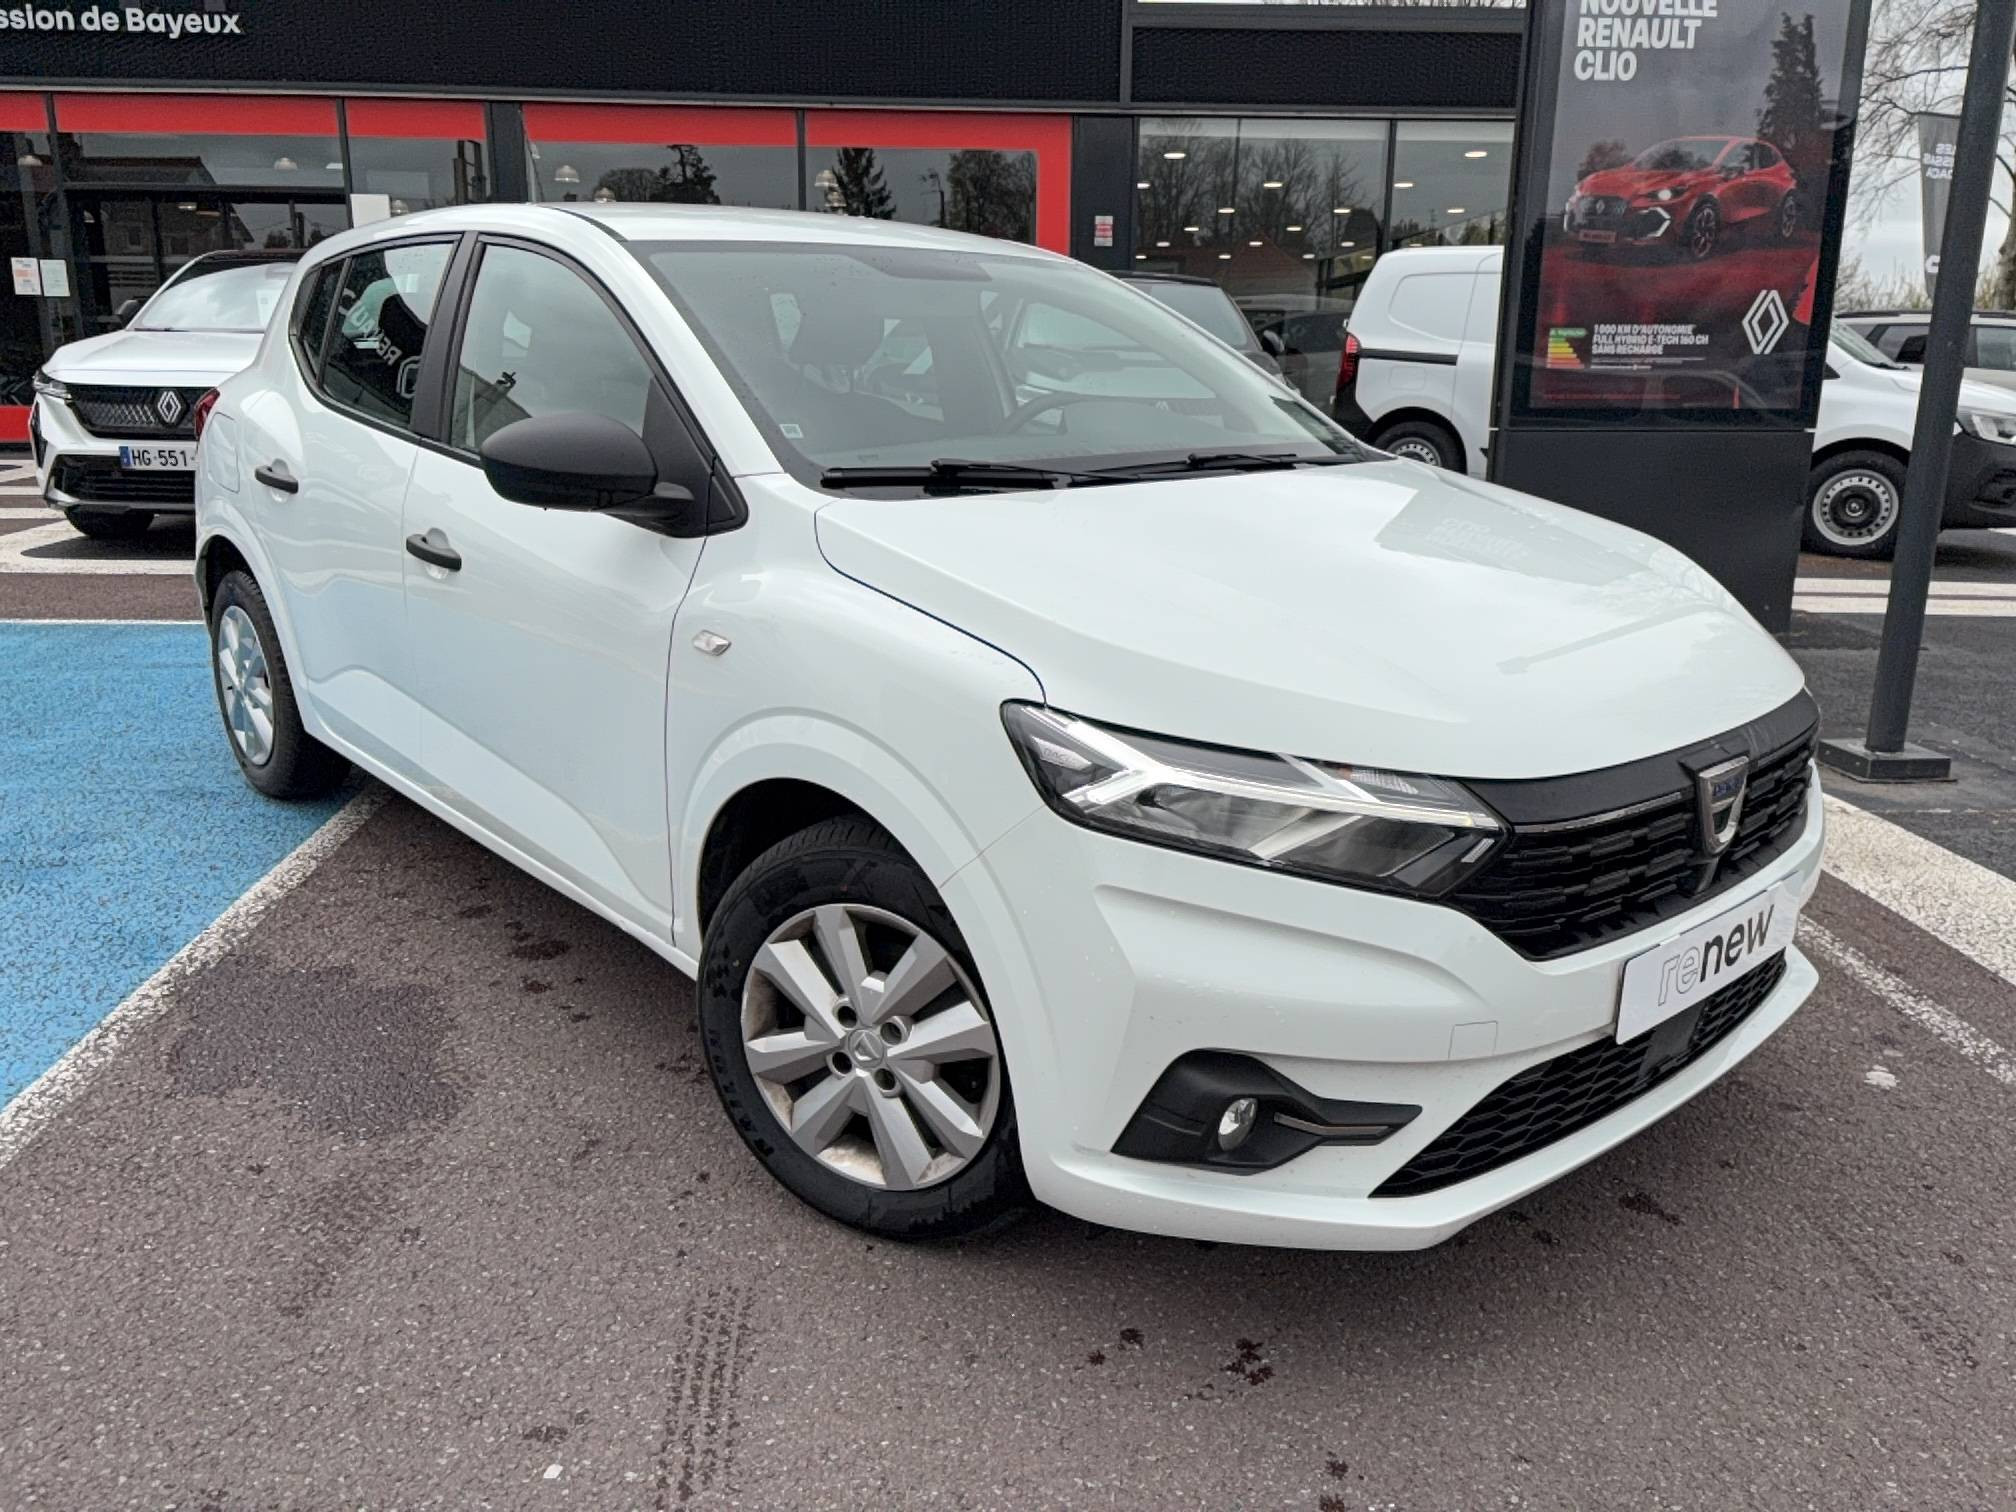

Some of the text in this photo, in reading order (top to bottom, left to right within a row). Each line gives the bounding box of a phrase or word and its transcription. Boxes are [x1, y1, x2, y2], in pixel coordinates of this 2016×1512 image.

[80, 5, 119, 32] de
[125, 7, 242, 39] Bayeux
[1577, 16, 1702, 49] RENAULT
[1574, 50, 1637, 81] CLIO
[1658, 904, 1775, 1007] renew
